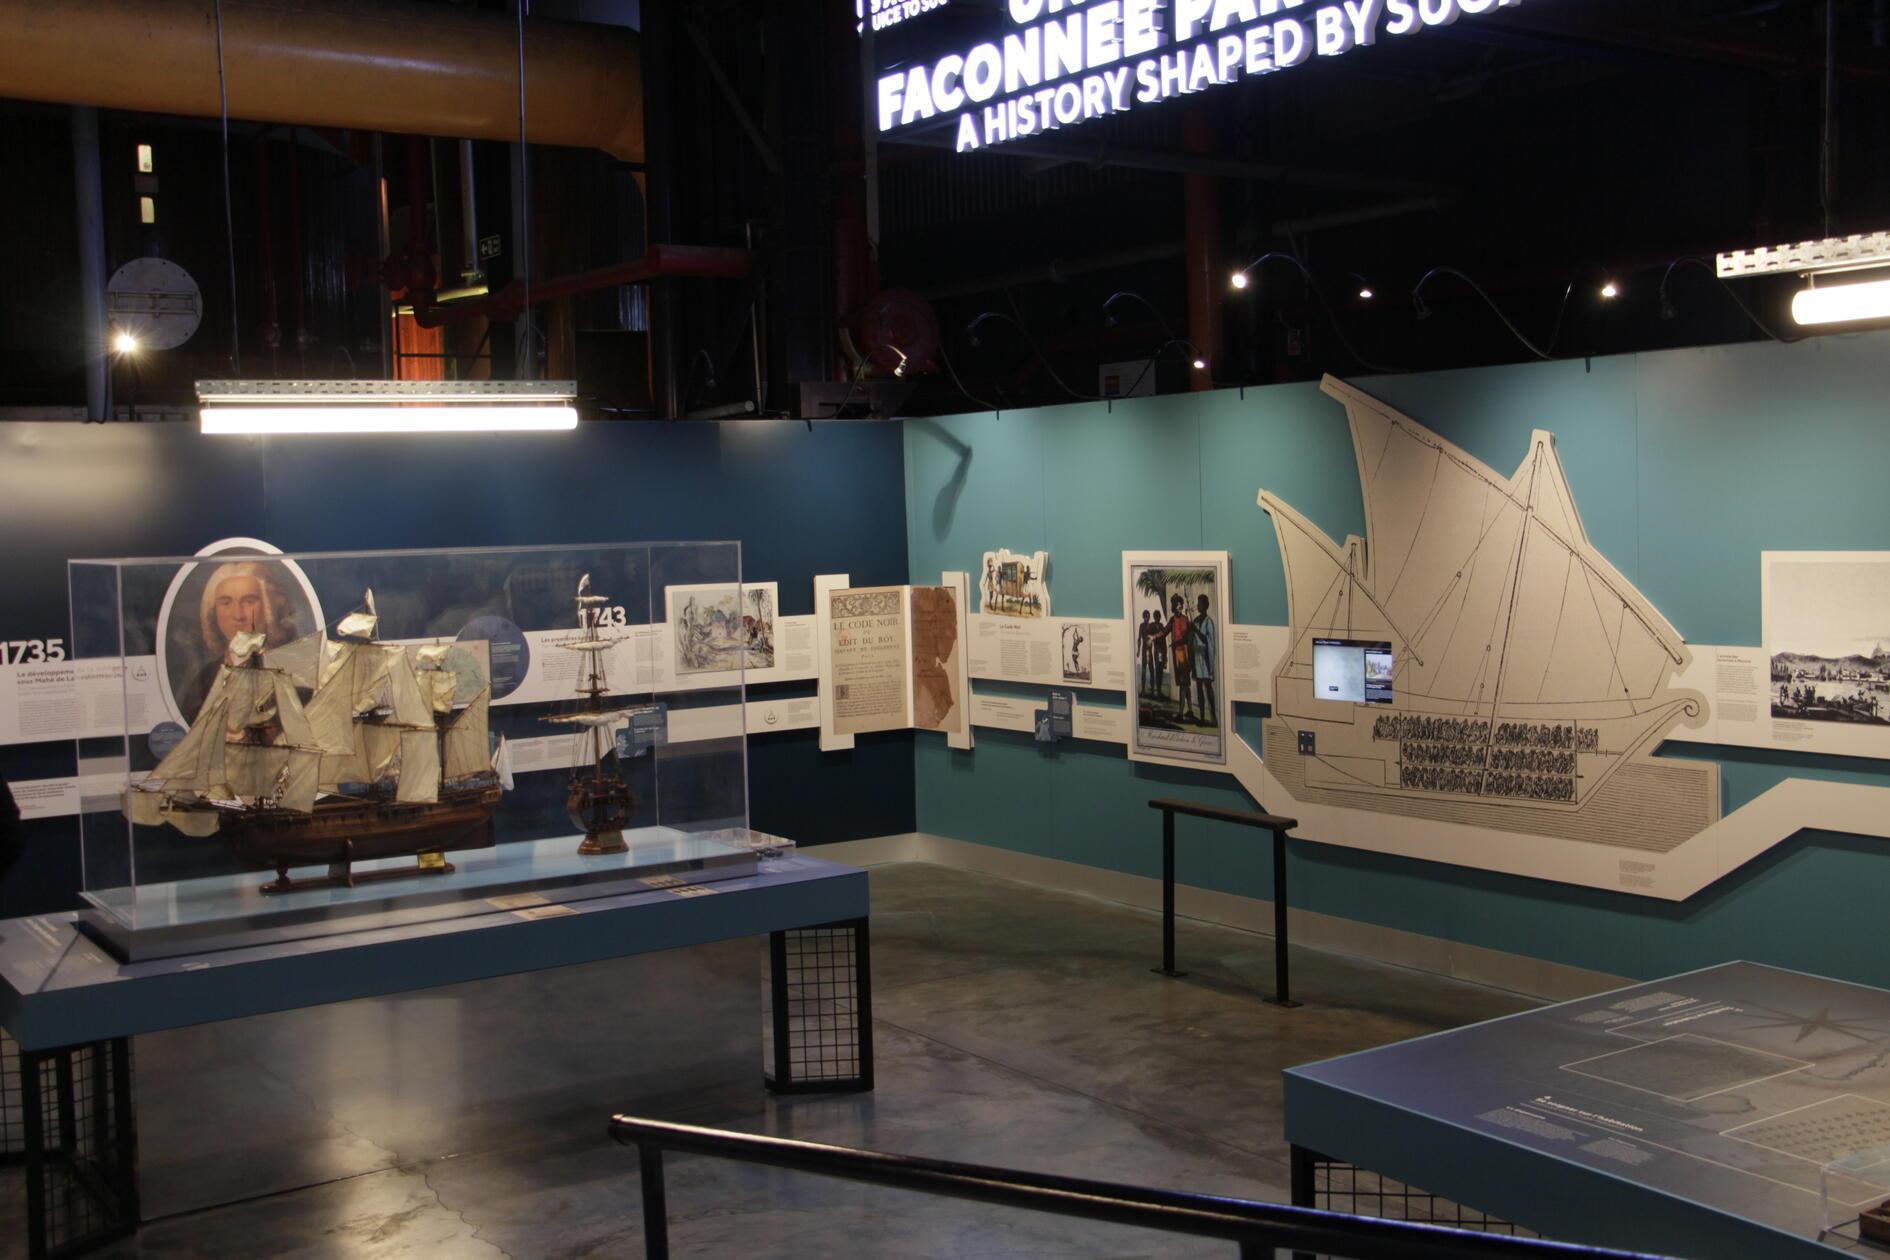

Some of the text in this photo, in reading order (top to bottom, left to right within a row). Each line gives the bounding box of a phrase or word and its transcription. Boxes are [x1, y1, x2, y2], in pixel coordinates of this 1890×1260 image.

[956, 113, 979, 153] A
[984, 66, 1129, 145] HISTORY
[1136, 18, 1303, 103] SHAPED
[1316, 0, 1376, 55] BY
[0, 638, 65, 665] 1735
